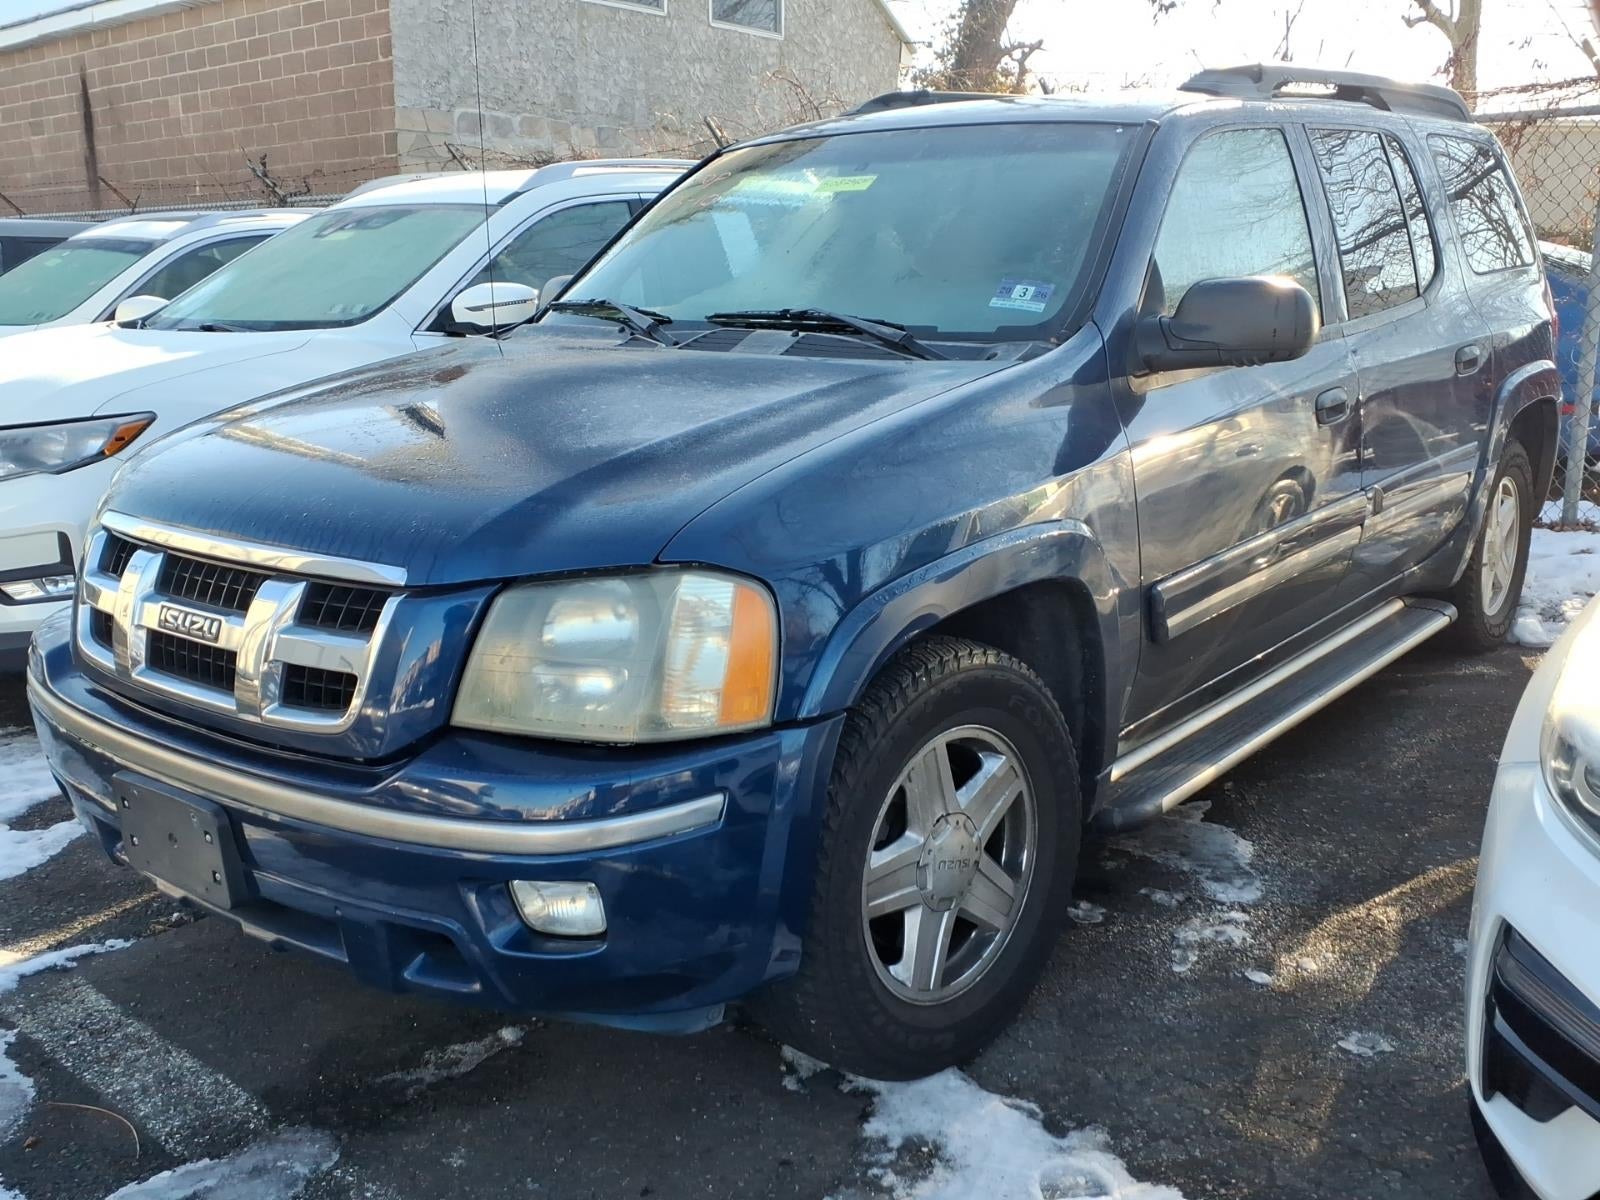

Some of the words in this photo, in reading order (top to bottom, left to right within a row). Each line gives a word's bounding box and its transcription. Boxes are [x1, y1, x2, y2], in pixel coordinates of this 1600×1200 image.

[1019, 287, 1029, 298] 3
[1034, 290, 1048, 299] 26
[160, 606, 220, 639] ISUZU
[938, 859, 971, 871] ISUZU
